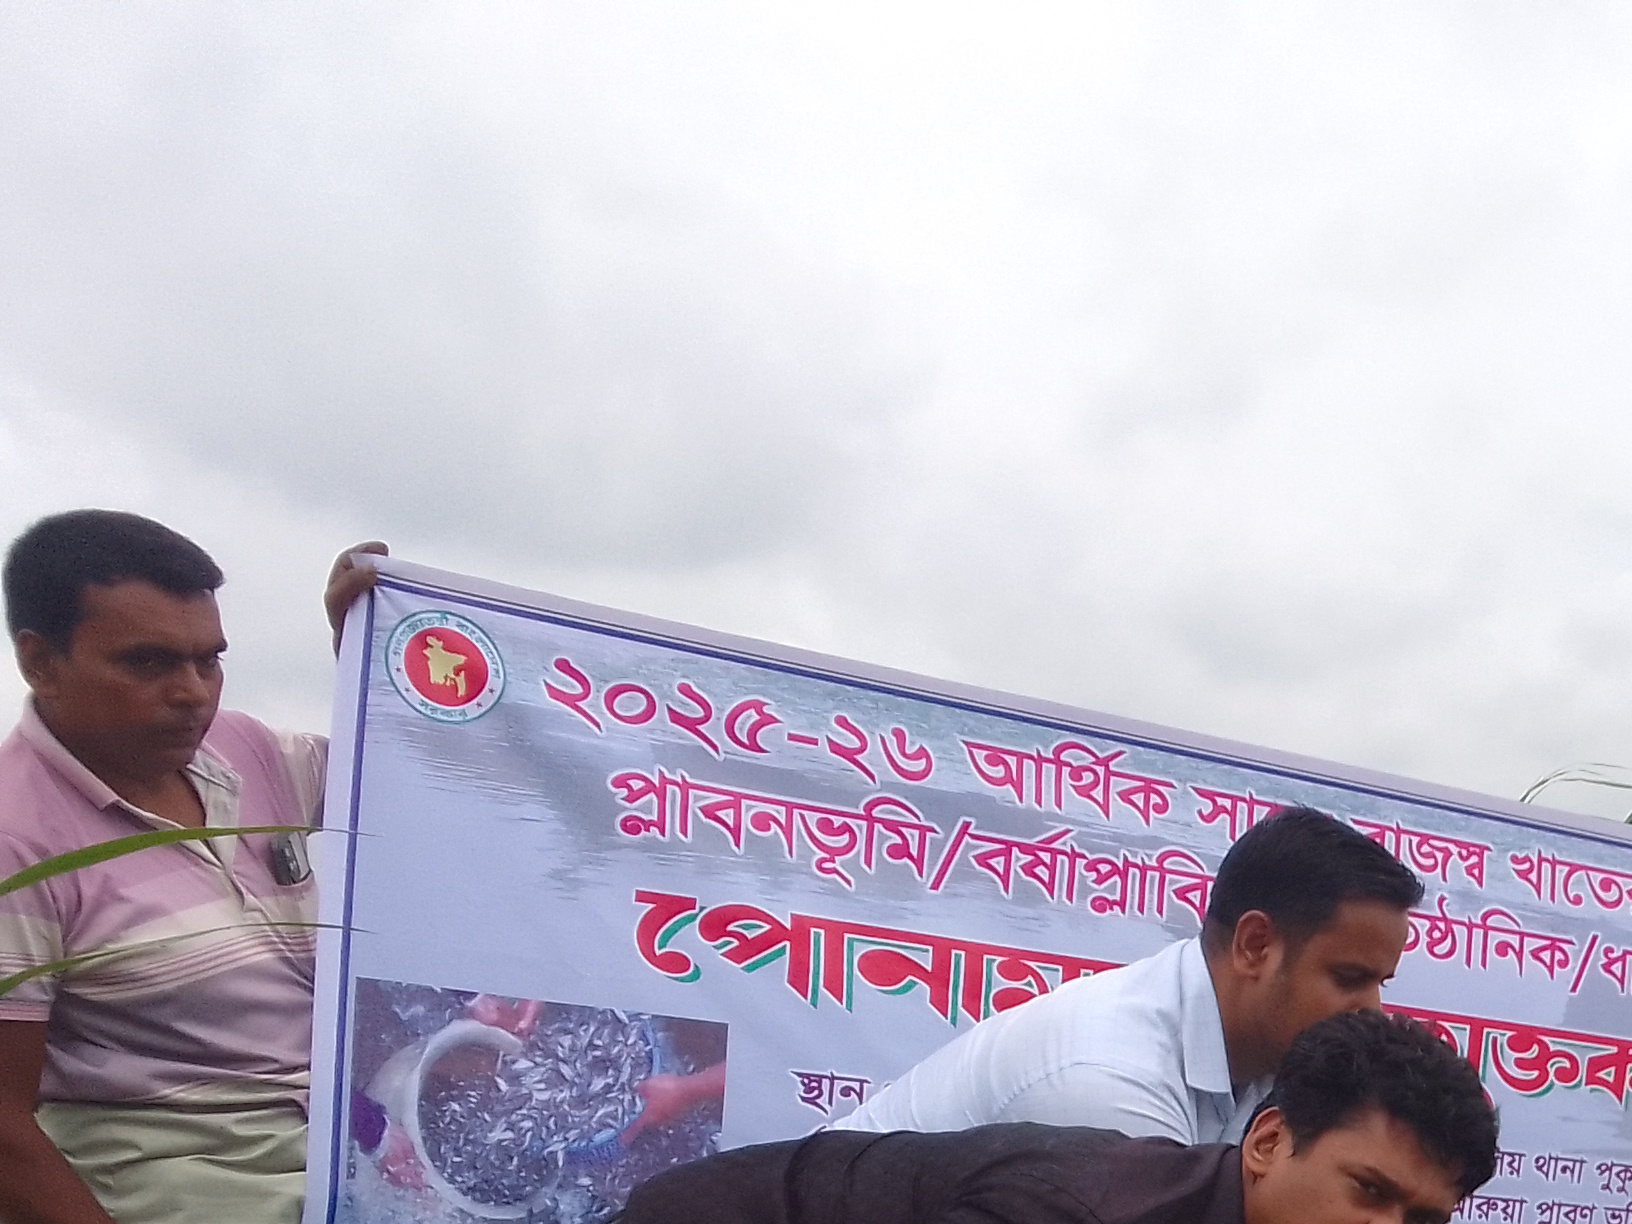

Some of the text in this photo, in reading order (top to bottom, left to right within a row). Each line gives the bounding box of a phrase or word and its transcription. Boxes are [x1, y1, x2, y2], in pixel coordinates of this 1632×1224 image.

[543, 657, 933, 784] ২০২৫-২৬
[962, 740, 1174, 826] আর্থিক
[1190, 785, 1290, 842] সা
[609, 767, 1216, 924] প্লাবনভূমি/বর্ষাপ্লাবি
[790, 1071, 871, 1115] স্থান
[1534, 1151, 1588, 1184] থানা
